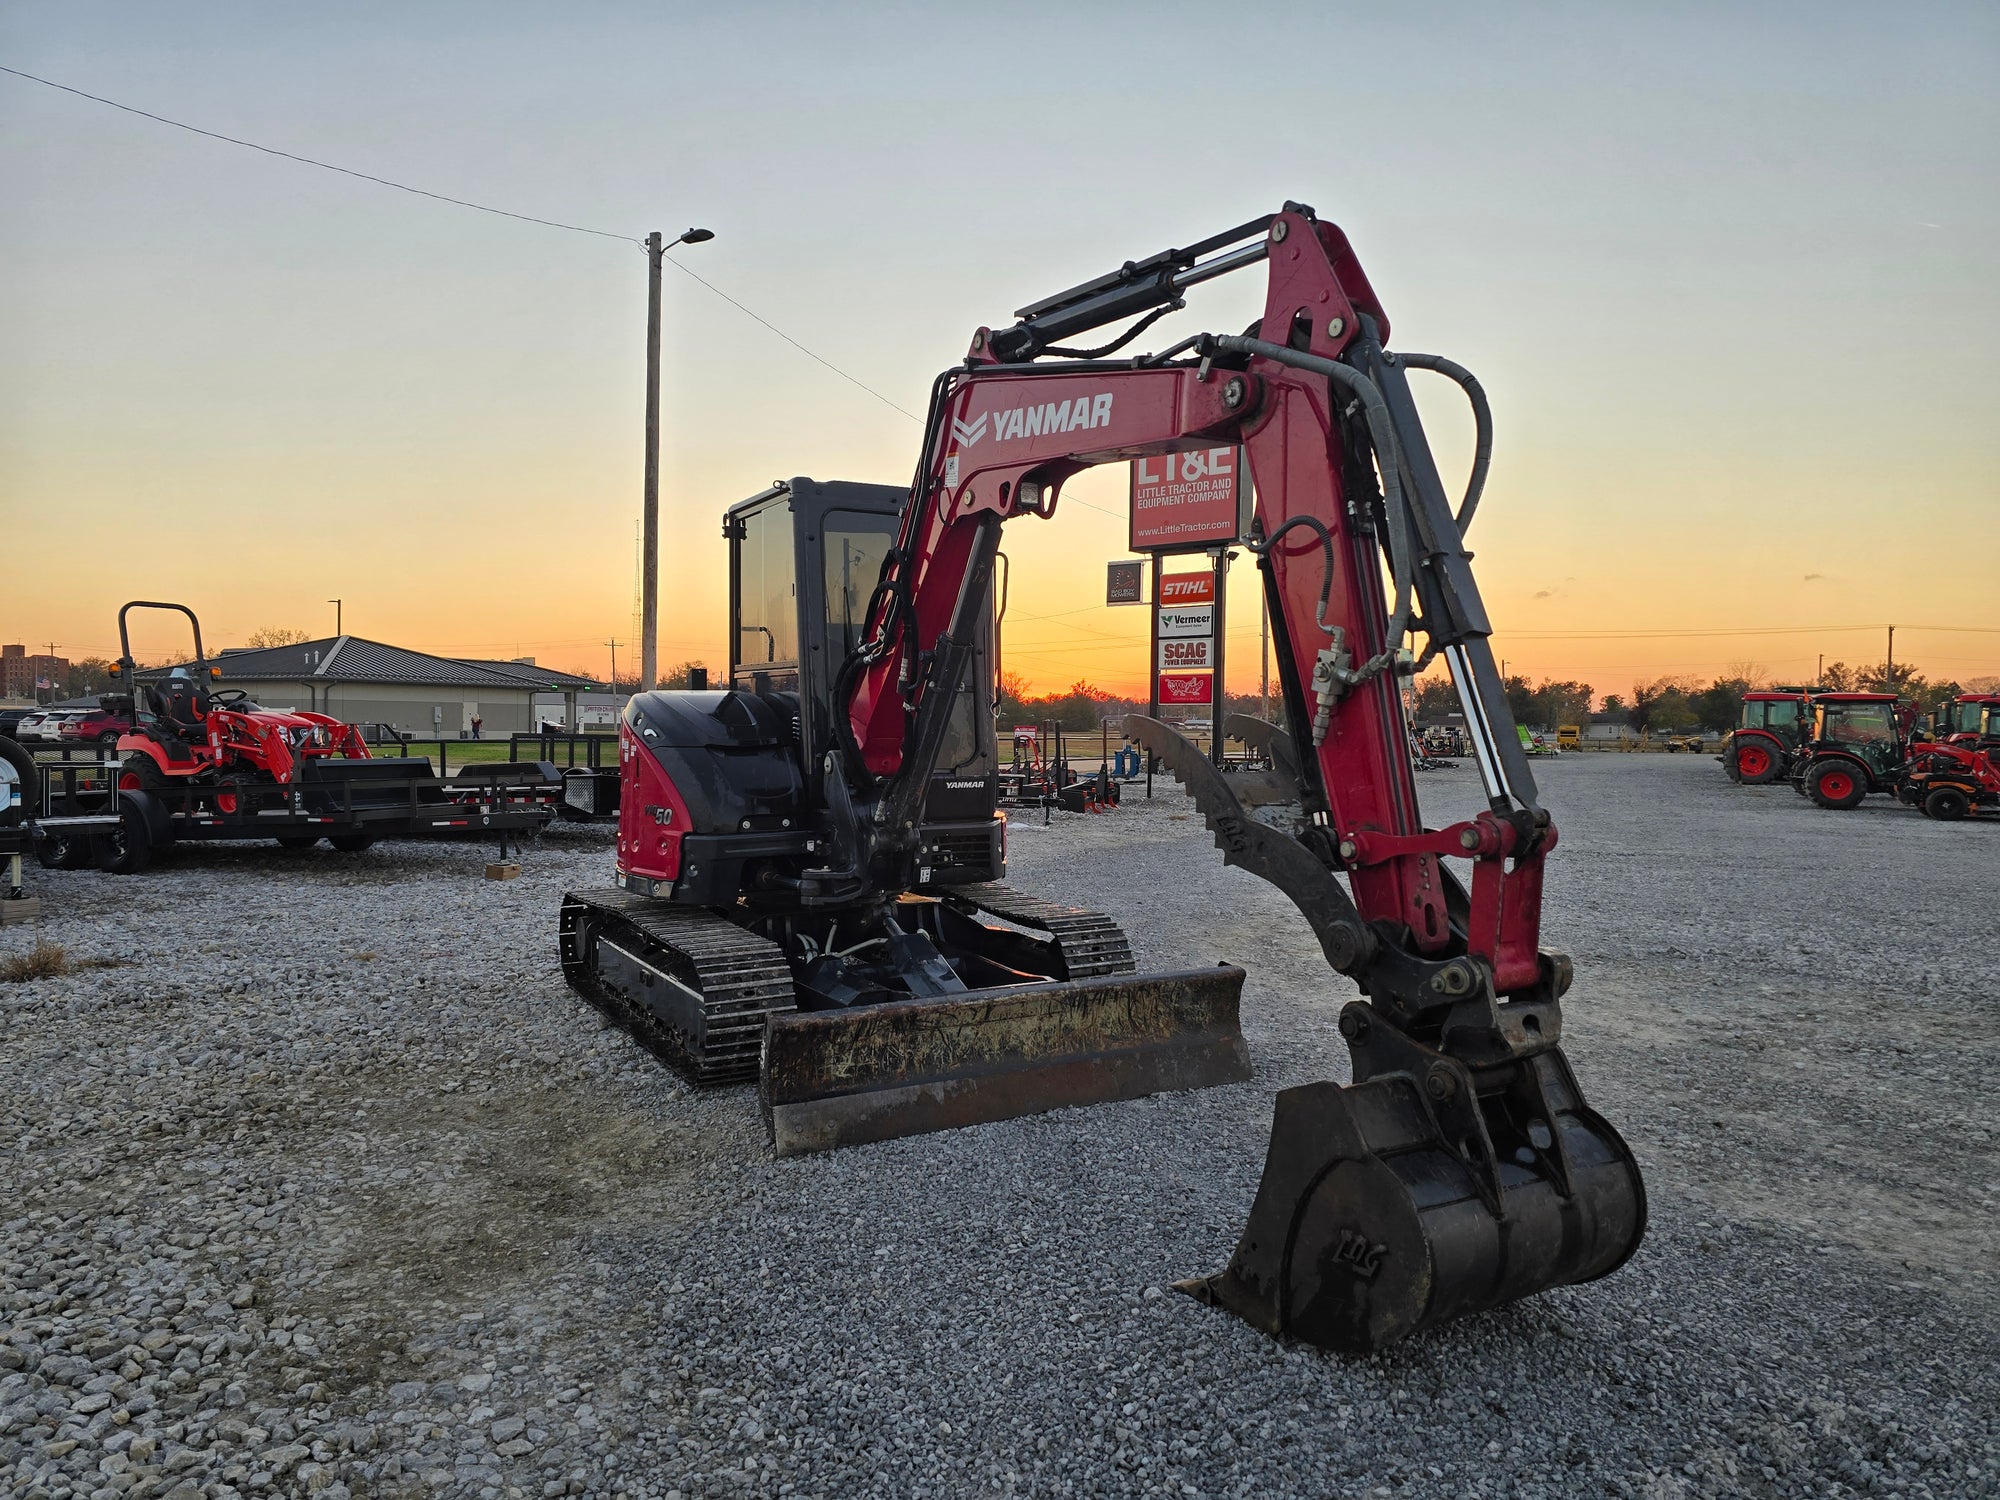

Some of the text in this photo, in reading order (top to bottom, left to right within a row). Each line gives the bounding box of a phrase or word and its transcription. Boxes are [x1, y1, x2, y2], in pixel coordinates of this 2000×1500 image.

[993, 392, 1113, 442] YANMAR
[1137, 478, 1232, 499] LITTLE TRACTOR AND
[1137, 490, 1231, 509] EQUIPMENT COMPANY
[1138, 520, 1231, 537] www.LittleTractor.com
[1163, 580, 1209, 596] STIHL
[1174, 615, 1210, 625] Vermeer
[1164, 642, 1207, 659] SCAG
[946, 781, 985, 789] YANMAR
[655, 808, 673, 825] 50
